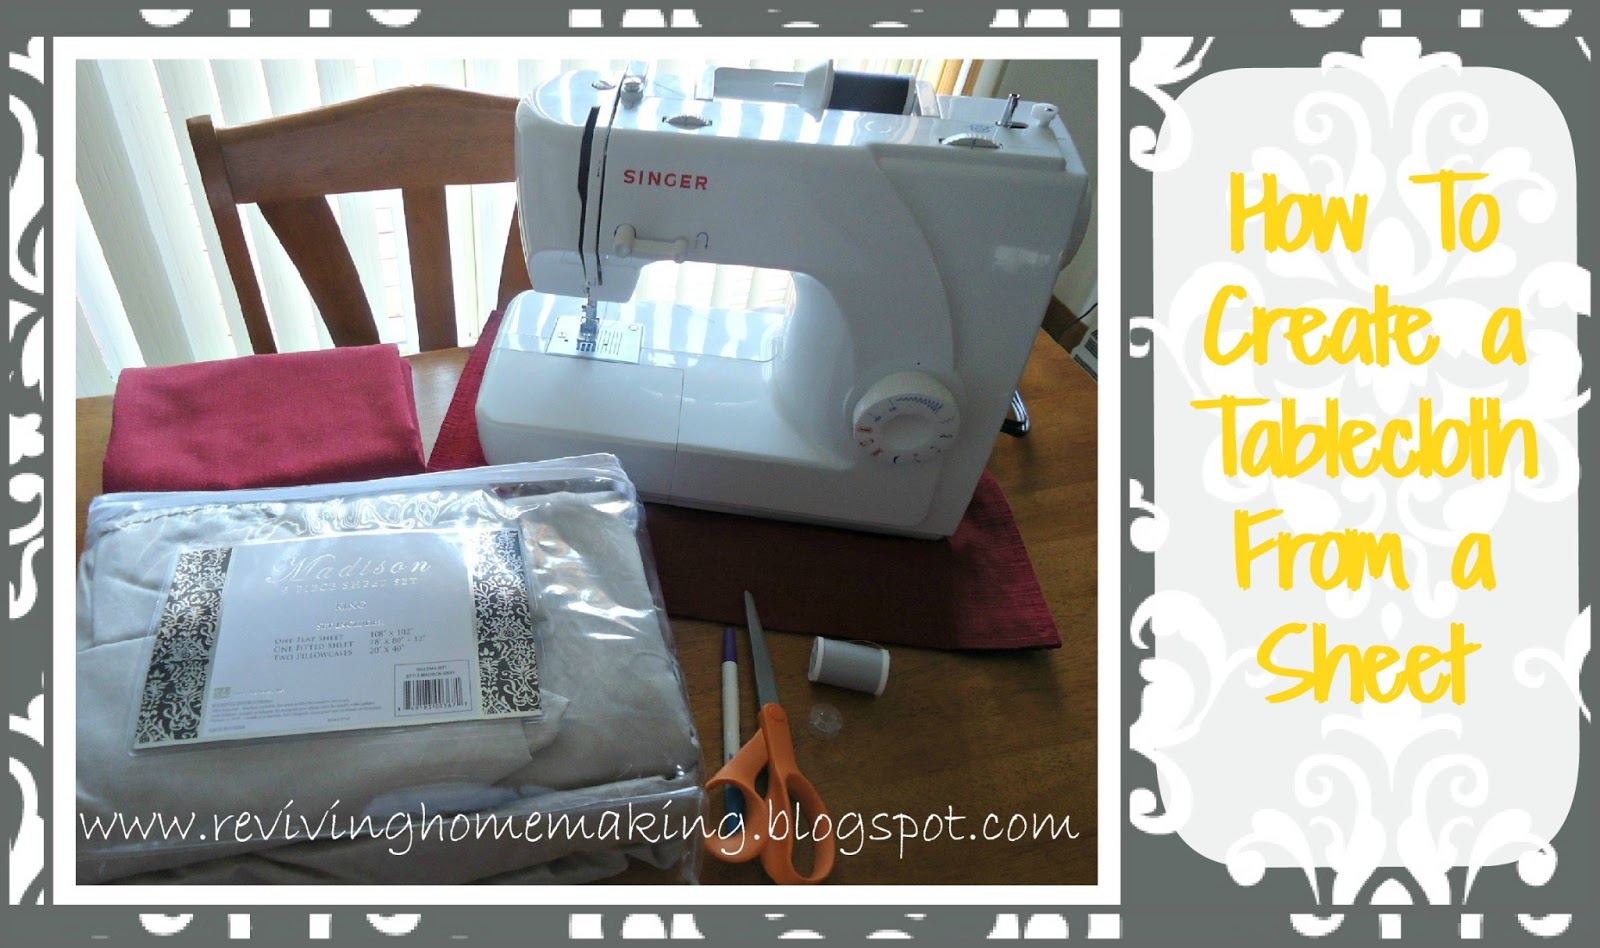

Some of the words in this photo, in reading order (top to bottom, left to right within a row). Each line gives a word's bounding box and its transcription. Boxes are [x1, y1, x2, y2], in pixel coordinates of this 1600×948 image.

[623, 169, 708, 190] SINGER
[265, 553, 431, 583] Madison
[394, 577, 418, 586] SET
[335, 600, 367, 611] KING
[273, 645, 292, 653] ONE
[327, 641, 354, 649] SHEET
[296, 649, 353, 660] PILLOWCASES
